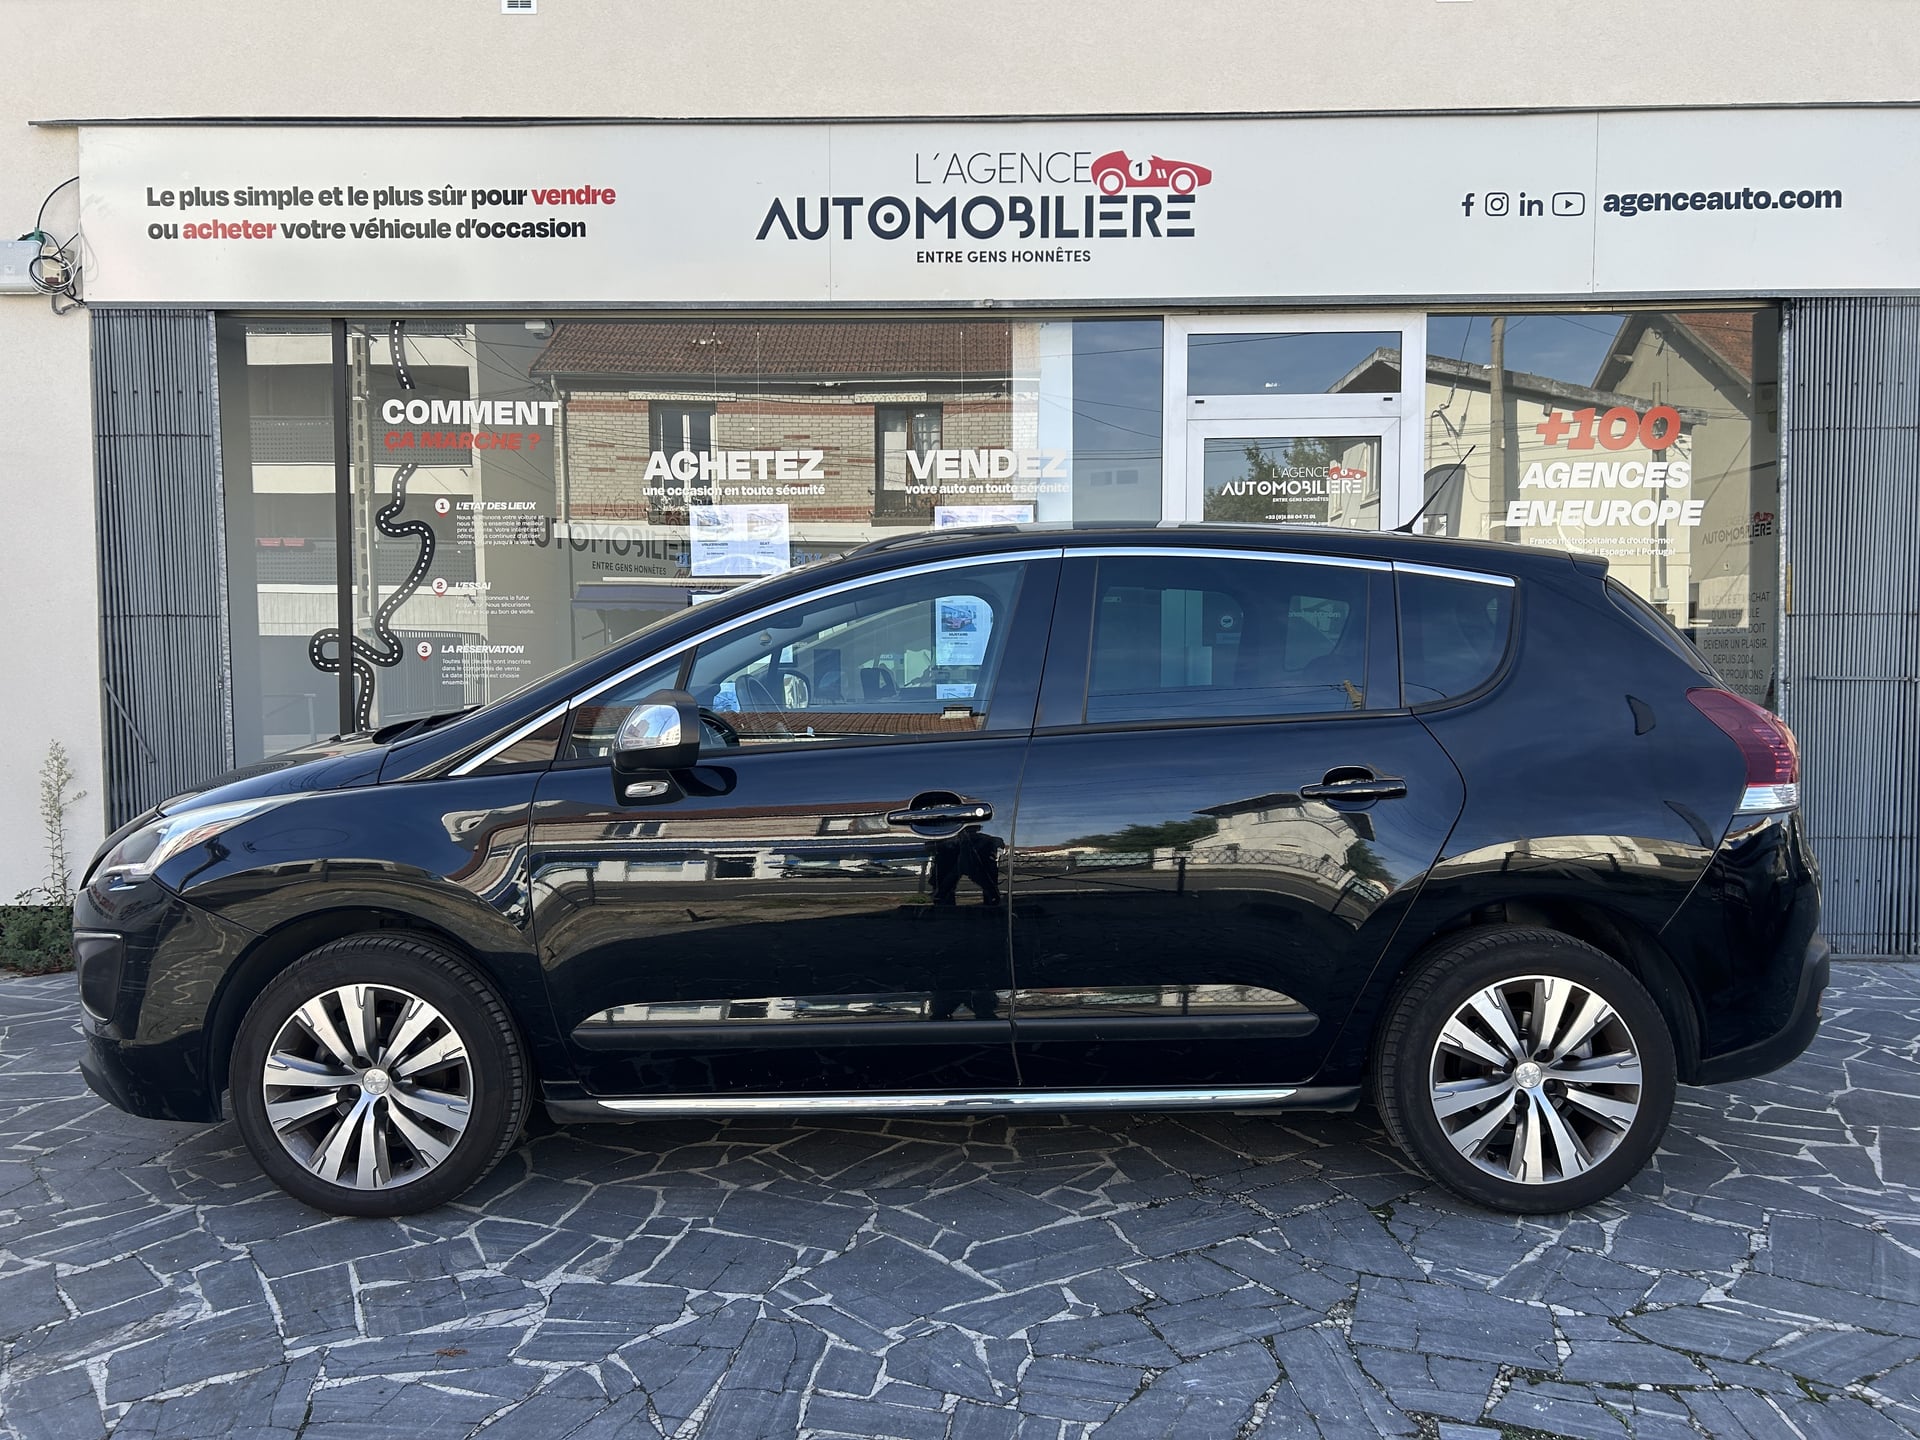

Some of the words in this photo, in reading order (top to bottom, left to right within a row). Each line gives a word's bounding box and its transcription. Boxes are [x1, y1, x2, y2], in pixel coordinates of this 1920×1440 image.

[915, 151, 1091, 184] L'AGENCE
[1135, 162, 1143, 177] 1
[147, 187, 174, 206] Le
[180, 187, 229, 210] plus
[234, 186, 313, 210] simple
[319, 187, 343, 206] et
[348, 186, 368, 206] le
[373, 186, 423, 209] plus
[428, 184, 467, 205] sûr
[472, 190, 527, 209] pour
[531, 185, 616, 205] vendre
[1603, 188, 1842, 217] agenceauto.com
[148, 224, 178, 239] ou
[183, 220, 276, 239] acheter
[281, 220, 345, 239] votre
[350, 217, 451, 239] véhicule
[456, 218, 586, 238] d'occasion
[917, 251, 962, 263] ENTRE
[968, 251, 1006, 262] GENS
[1012, 247, 1090, 262] HONNÊTES
[382, 399, 559, 426] COMMENT
[1536, 406, 1681, 450] +100
[383, 431, 416, 453] ÇA
[420, 432, 522, 450] MARCHE
[528, 433, 541, 450] ?
[643, 450, 824, 480] ACHETEZ
[906, 449, 1068, 480] VENDEZ
[1272, 466, 1329, 479] L'AGENCE
[1518, 461, 1691, 489] AGENCES
[643, 487, 665, 496] une
[667, 485, 722, 496] occasion
[724, 487, 739, 496] en
[741, 486, 774, 496] toute
[776, 484, 826, 496] sécurité
[905, 484, 937, 495] votre
[939, 485, 966, 495] auto
[968, 485, 984, 494] en
[985, 484, 1018, 494] toute
[1021, 482, 1070, 494] sérénité
[487, 502, 507, 510] DES
[508, 502, 536, 510] LIEUX
[1505, 500, 1556, 527] EN
[1558, 500, 1705, 527] EUROPE
[1529, 537, 1557, 545] France
[592, 561, 613, 571] ENTRE
[614, 563, 633, 573] GENS
[1748, 623, 1766, 633] DOIT
[441, 645, 455, 654] LA
[1703, 640, 1729, 649] DEVENIR
[1731, 640, 1740, 648] UN
[1713, 655, 1736, 664] DEPUIS
[1726, 669, 1763, 679] PROUVONS
